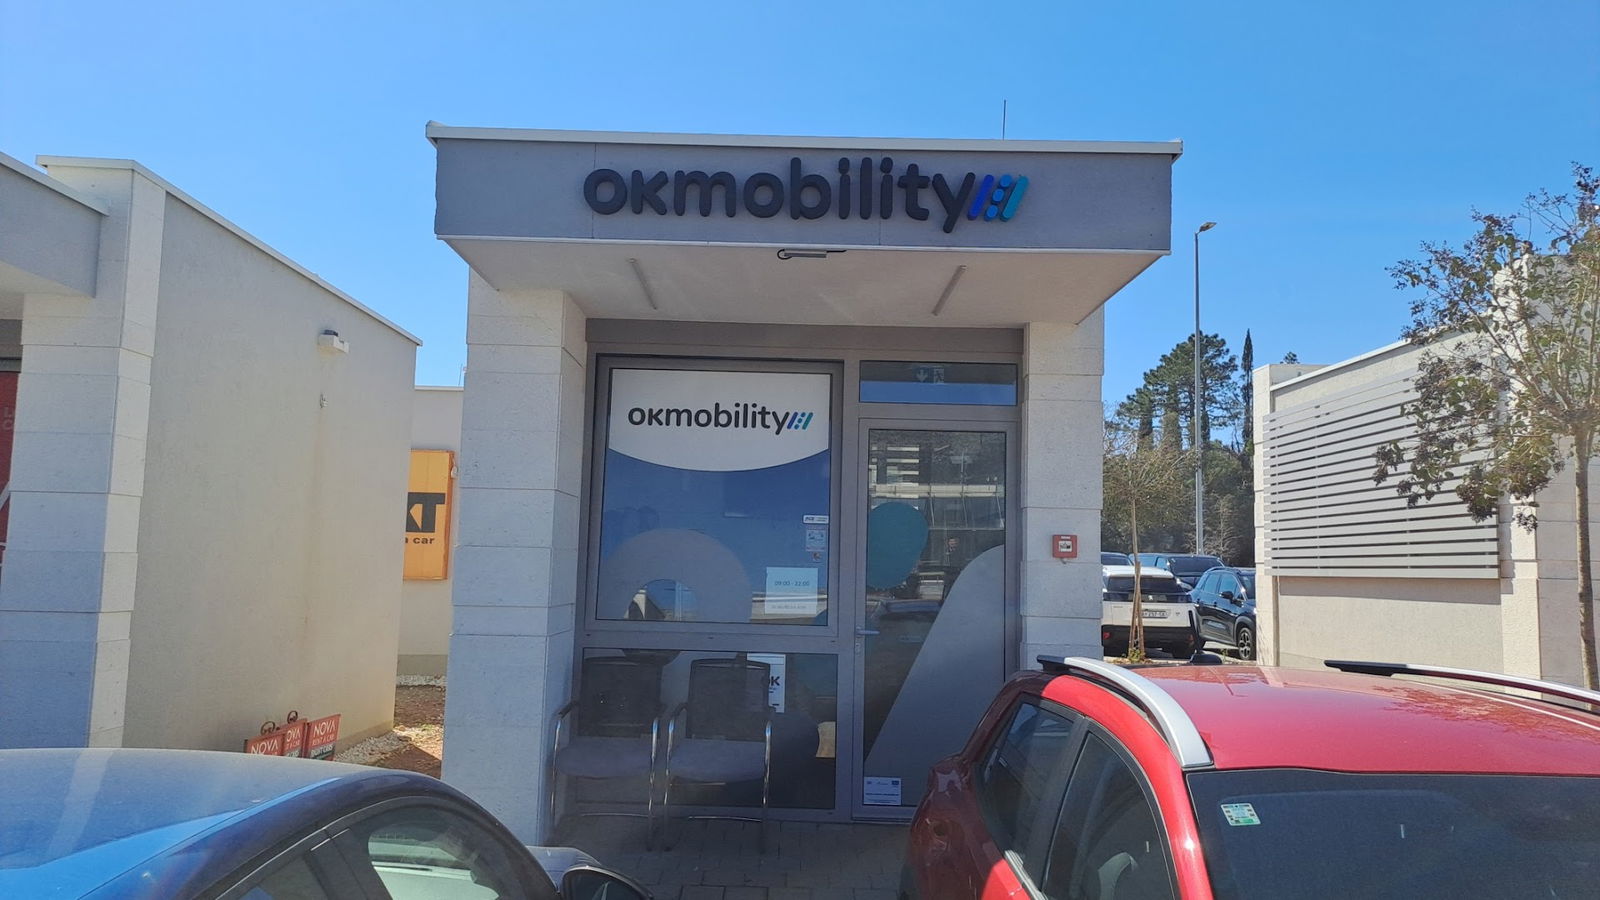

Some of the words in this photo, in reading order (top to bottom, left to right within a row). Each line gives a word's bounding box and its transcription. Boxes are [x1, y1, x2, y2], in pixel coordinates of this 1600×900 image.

[583, 157, 975, 233] okmobility
[628, 402, 790, 435] okmobility
[769, 676, 780, 686] K
[286, 727, 301, 742] OVA
[313, 720, 335, 738] NOVA
[251, 739, 278, 755] NOVA
